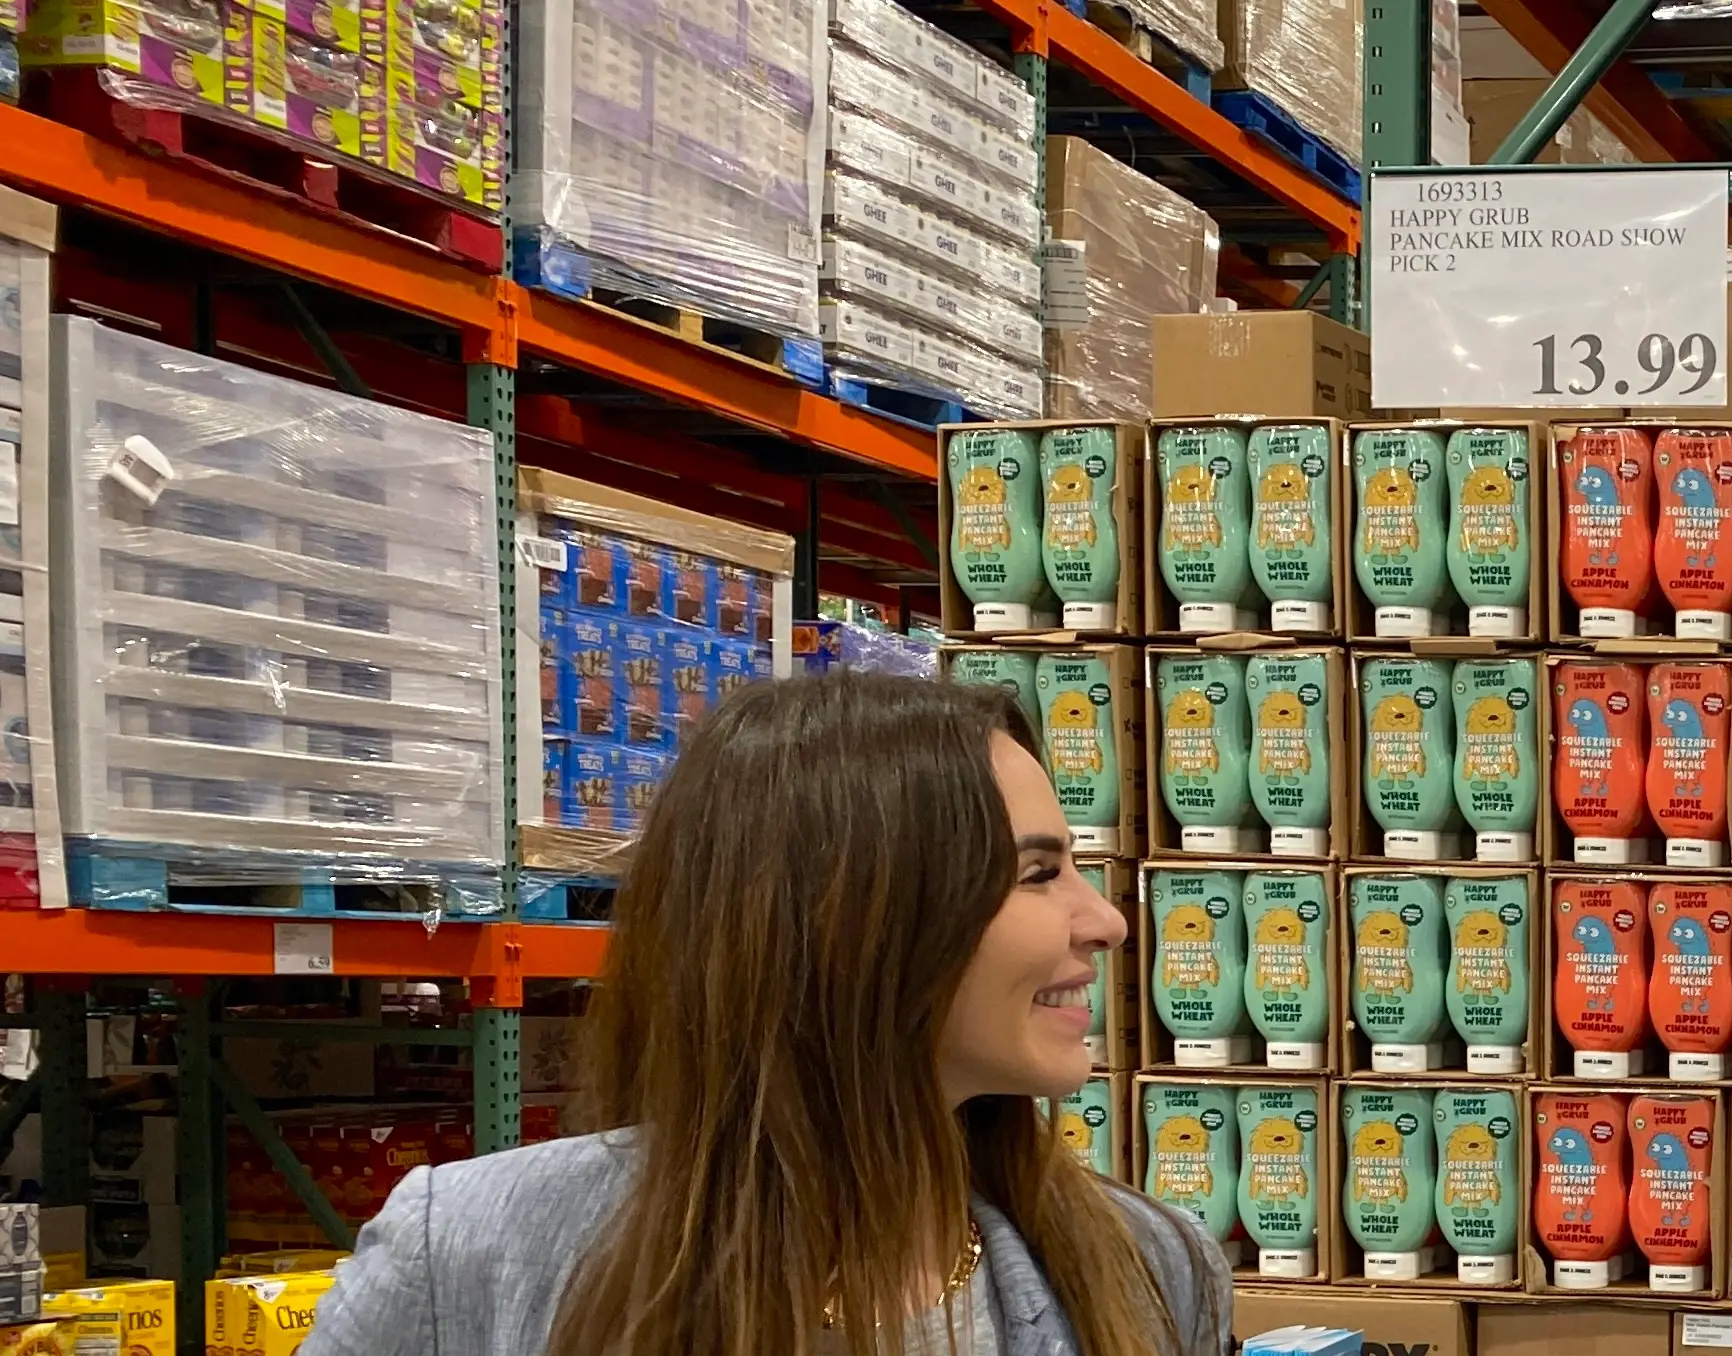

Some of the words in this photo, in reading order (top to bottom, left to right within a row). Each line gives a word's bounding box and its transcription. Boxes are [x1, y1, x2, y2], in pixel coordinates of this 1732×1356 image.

[935, 174, 956, 195] GHEE
[1418, 181, 1503, 202] 1693313
[863, 204, 887, 224] GHEE
[1391, 209, 1462, 227] HAPPY
[1469, 208, 1529, 225] GRUB
[936, 236, 958, 255] GHEE
[1390, 231, 1493, 251] PANCAKE
[1501, 230, 1542, 248] MIX
[1551, 229, 1613, 247] ROAD
[1621, 228, 1686, 246] SHOW
[1390, 255, 1438, 272] PICK
[1446, 255, 1456, 271] 2
[865, 266, 888, 286] GHEE
[1532, 332, 1717, 395] 13.99
[967, 563, 1007, 574] WHOLE
[967, 573, 1007, 584] WHEAT
[1171, 878, 1204, 888] HAPPY
[1178, 886, 1204, 896] GRUB
[1579, 890, 1612, 899] HAPPY
[1586, 898, 1612, 908] GRUB
[1159, 940, 1222, 952] SQUEEZABLE
[1167, 952, 1212, 962] INSTANT
[1566, 952, 1629, 964] SQUEEZABLE
[1167, 962, 1213, 973] PANCAKE
[1575, 964, 1619, 975] INSTANT
[1179, 972, 1201, 983] MIX
[1574, 974, 1619, 986] PANCAKE
[1586, 985, 1607, 995] MIX
[1171, 1001, 1213, 1012] WHOLE
[1171, 1010, 1214, 1022] WHEAT
[1581, 1012, 1613, 1023] APPLE
[1571, 1022, 1624, 1034] CINNAMON
